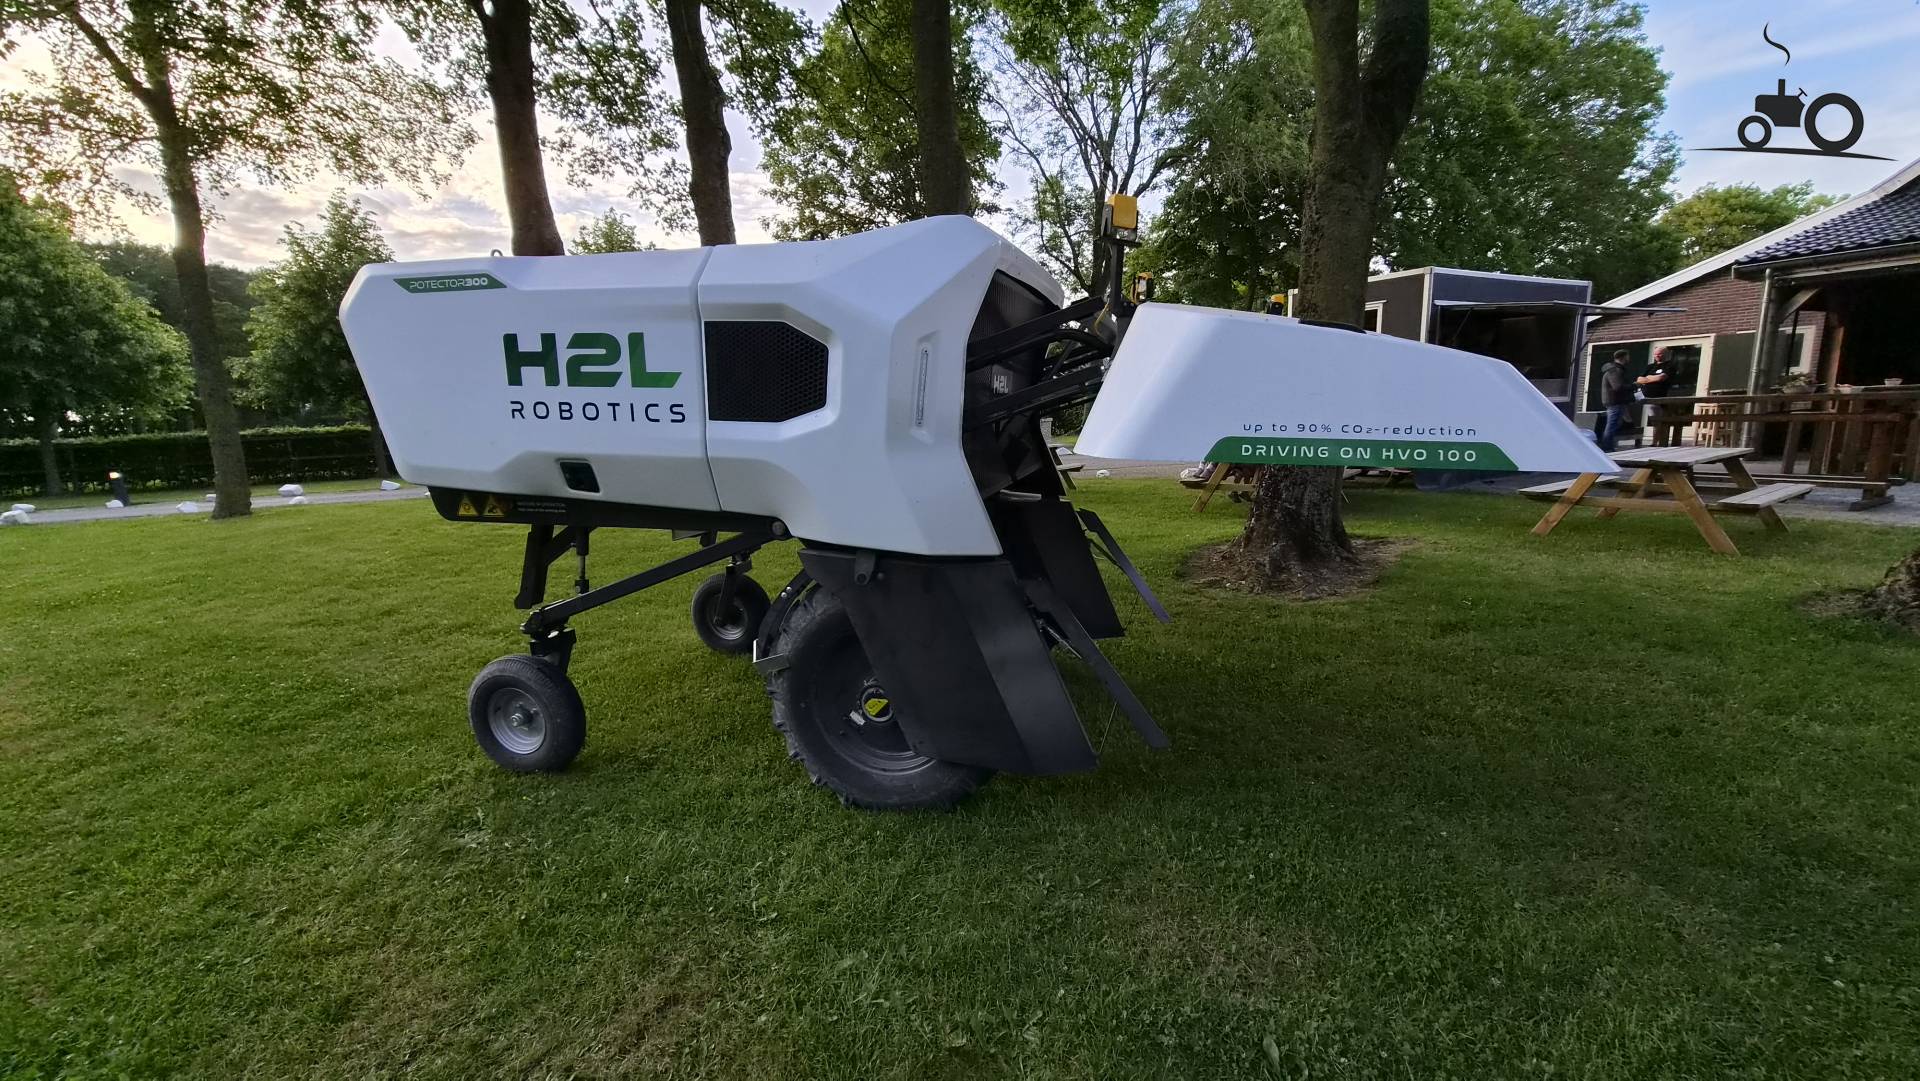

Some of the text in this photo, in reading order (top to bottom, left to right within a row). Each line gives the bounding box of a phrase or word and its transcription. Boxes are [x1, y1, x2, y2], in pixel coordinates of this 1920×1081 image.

[409, 277, 489, 289] POTECTOR300
[502, 332, 682, 388] H2L
[510, 400, 686, 423] ROBOTICS
[1243, 423, 1263, 434] up
[1272, 423, 1288, 432] to
[1297, 423, 1332, 433] 90%
[1241, 444, 1477, 462] DRIVING ON HVO 100
